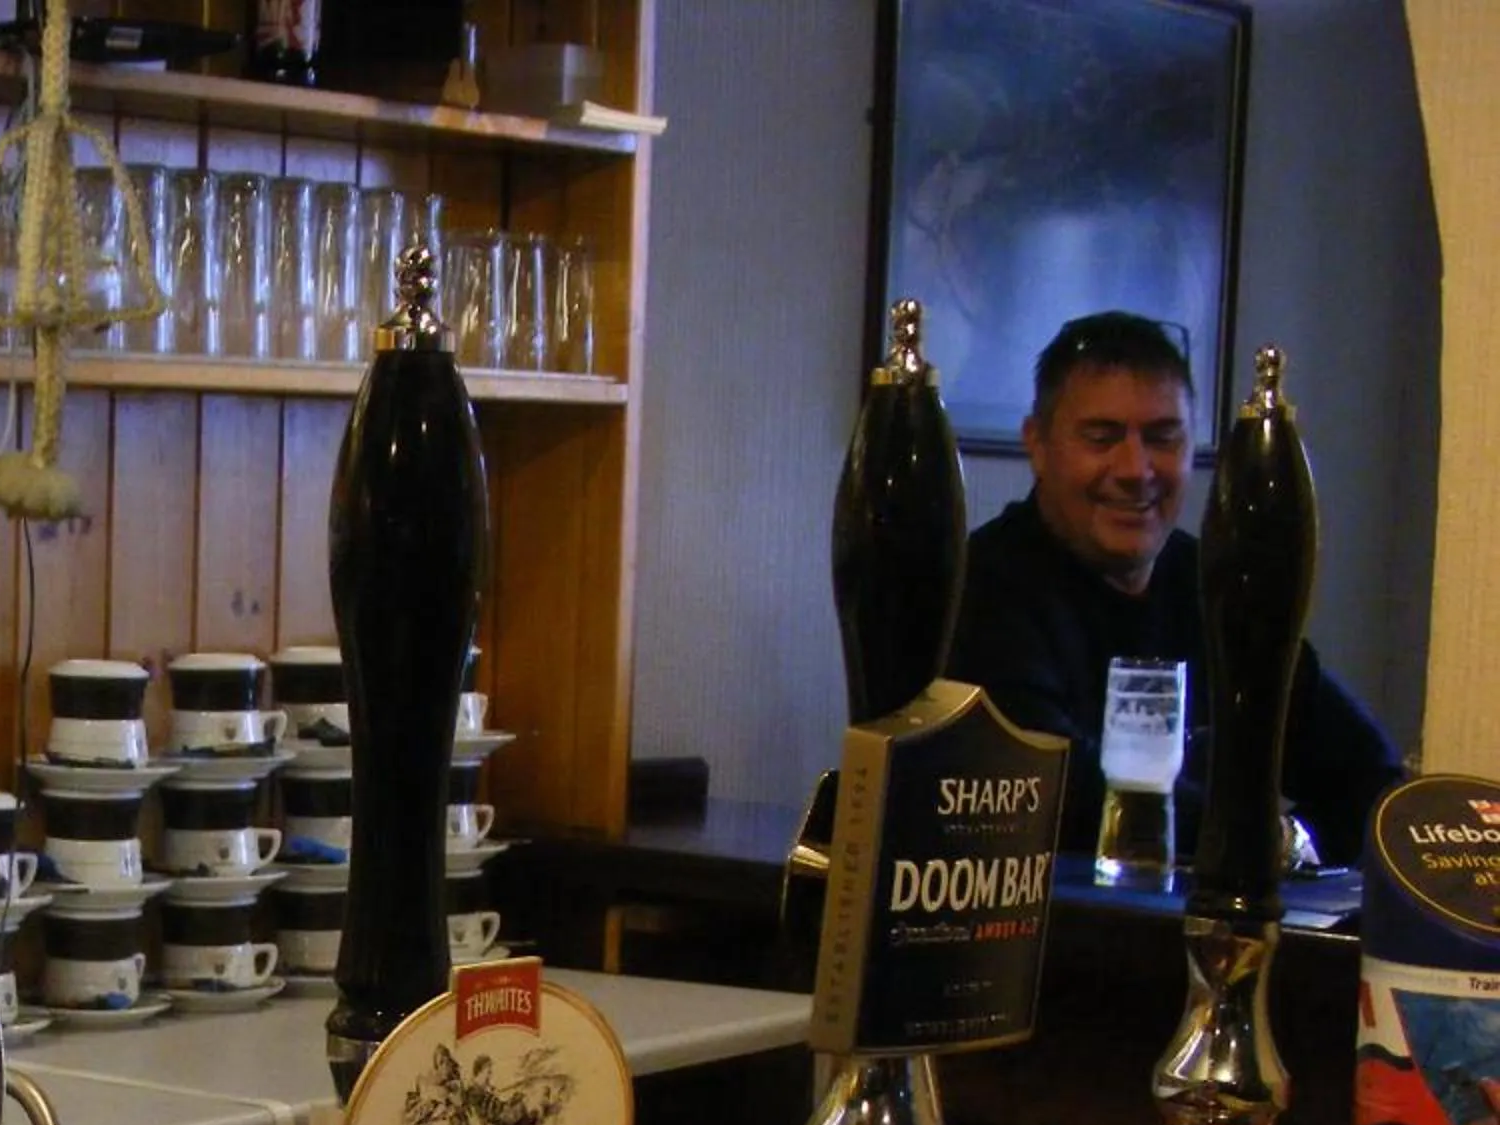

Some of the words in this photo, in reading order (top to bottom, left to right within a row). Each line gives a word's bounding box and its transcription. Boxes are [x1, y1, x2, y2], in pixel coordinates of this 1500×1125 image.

[937, 776, 1041, 815] SHARP'S
[889, 858, 1000, 912] DOOM
[1001, 854, 1047, 907] BAR
